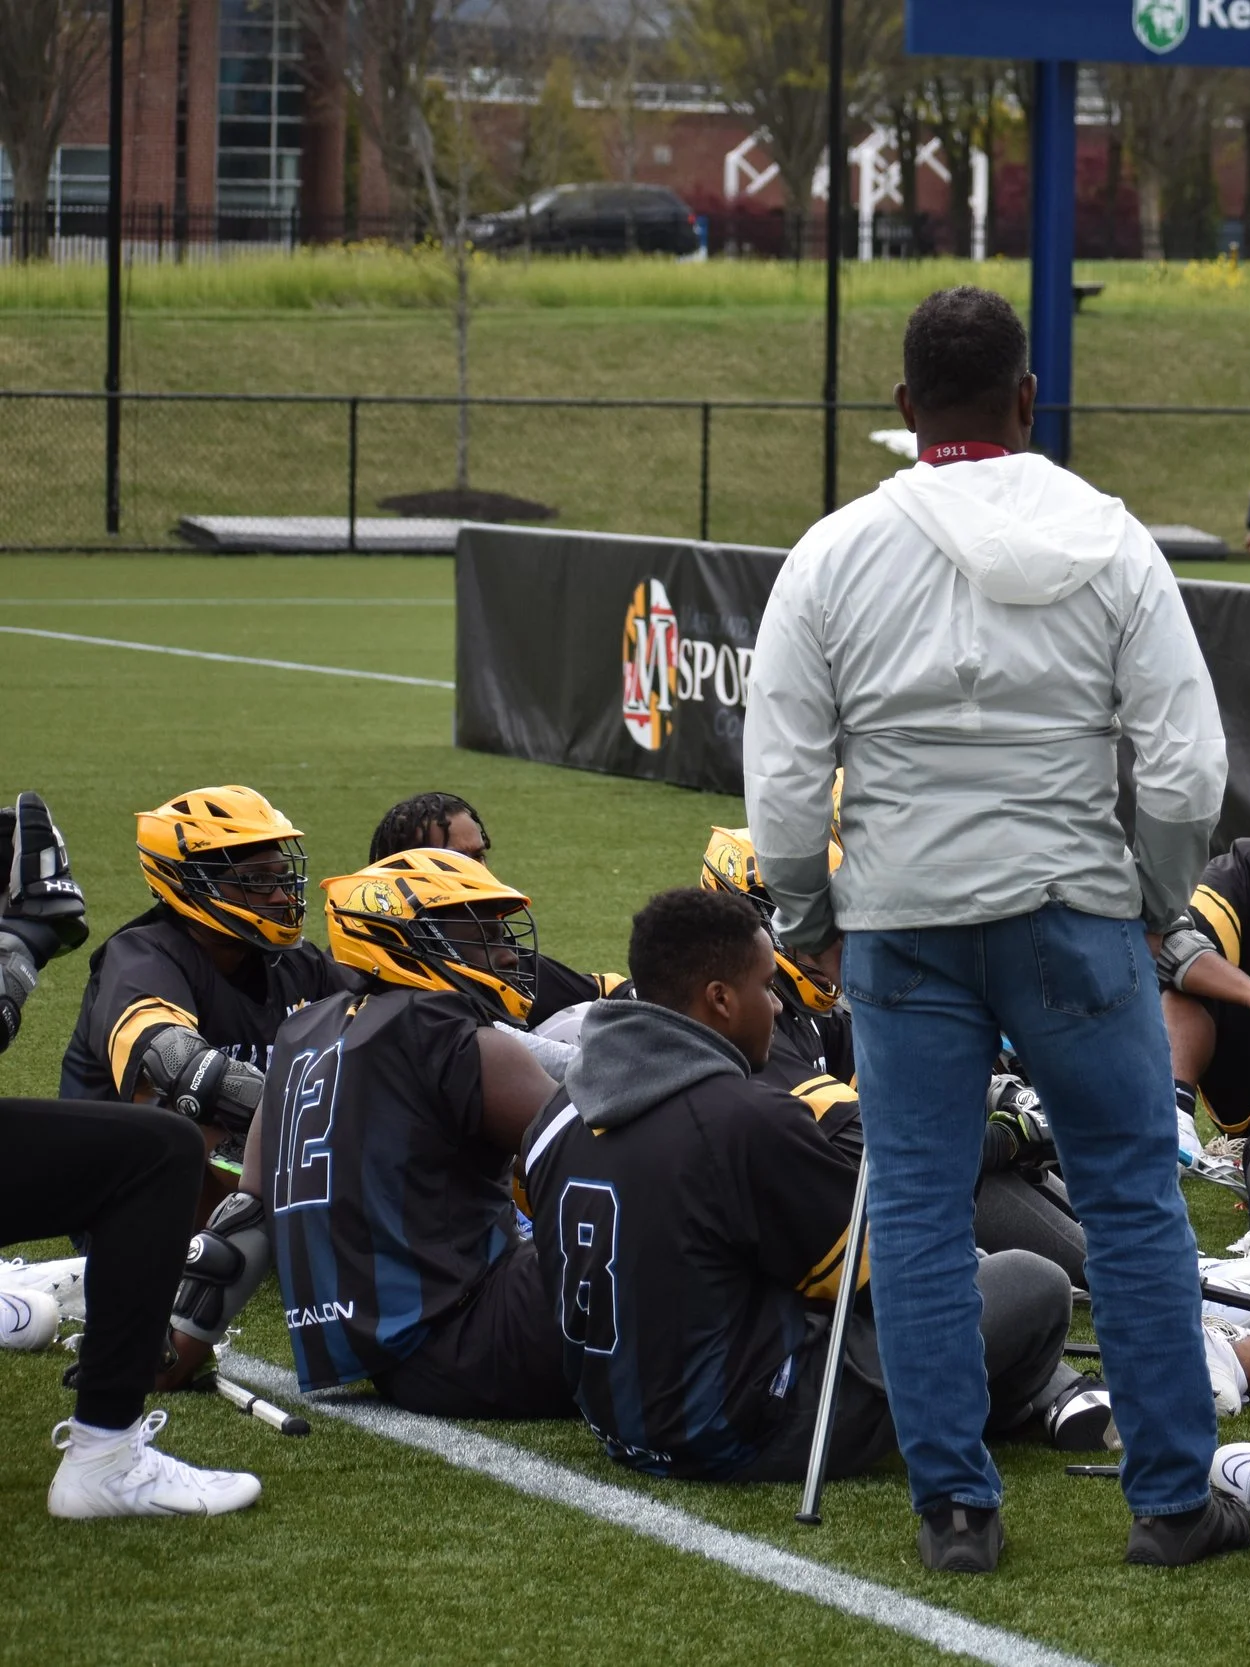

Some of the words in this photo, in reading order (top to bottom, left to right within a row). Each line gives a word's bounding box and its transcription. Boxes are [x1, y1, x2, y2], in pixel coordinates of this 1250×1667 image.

[935, 445, 968, 458] 1911
[274, 1039, 343, 1212] 12
[559, 1181, 618, 1354] 8
